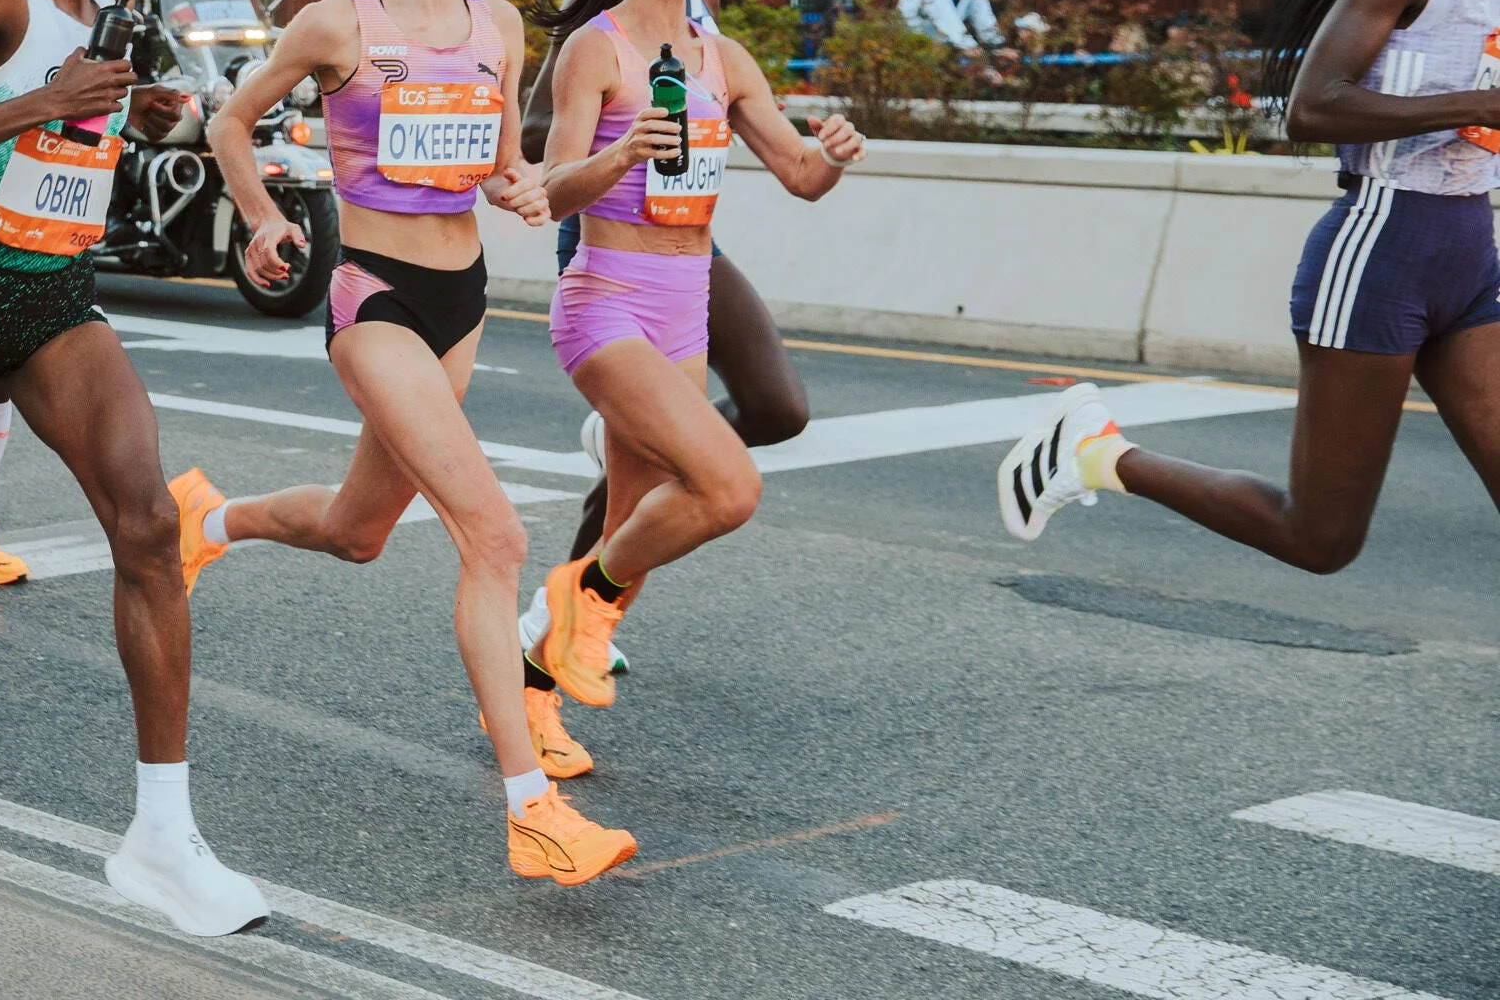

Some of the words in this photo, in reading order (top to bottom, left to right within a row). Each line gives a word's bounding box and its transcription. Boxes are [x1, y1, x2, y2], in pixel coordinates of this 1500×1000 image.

[398, 86, 426, 106] tcs
[389, 123, 493, 160] O'KEEFFE
[35, 172, 93, 218] OBIRI
[69, 231, 99, 248] 2025
